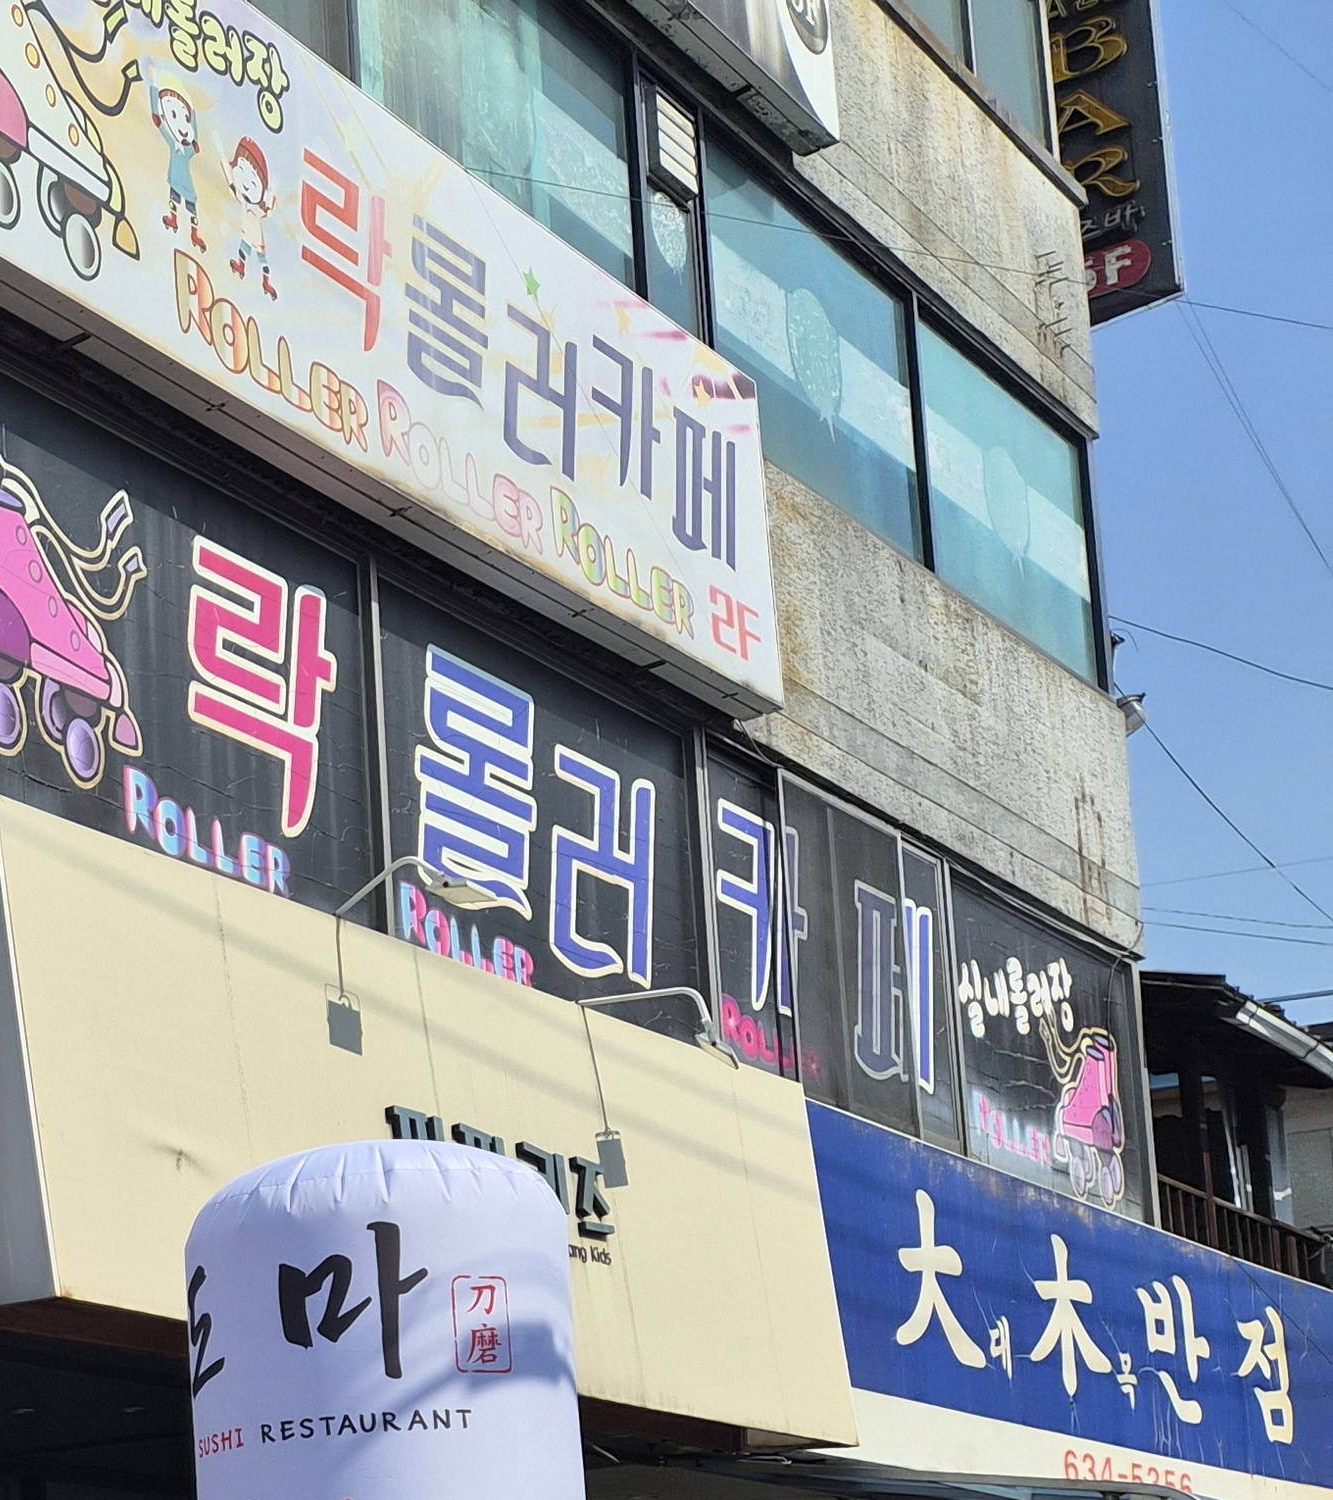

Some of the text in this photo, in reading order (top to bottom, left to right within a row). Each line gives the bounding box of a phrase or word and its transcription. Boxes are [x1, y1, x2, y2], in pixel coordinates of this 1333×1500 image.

[126, 0, 290, 134] 롤러장
[174, 248, 761, 663] ROLLER ROLLER ROLLER 2F
[124, 765, 291, 898] ROLLER
[400, 880, 534, 987] ROLLER
[198, 1409, 472, 1459] SUSHI RESTAURANT
